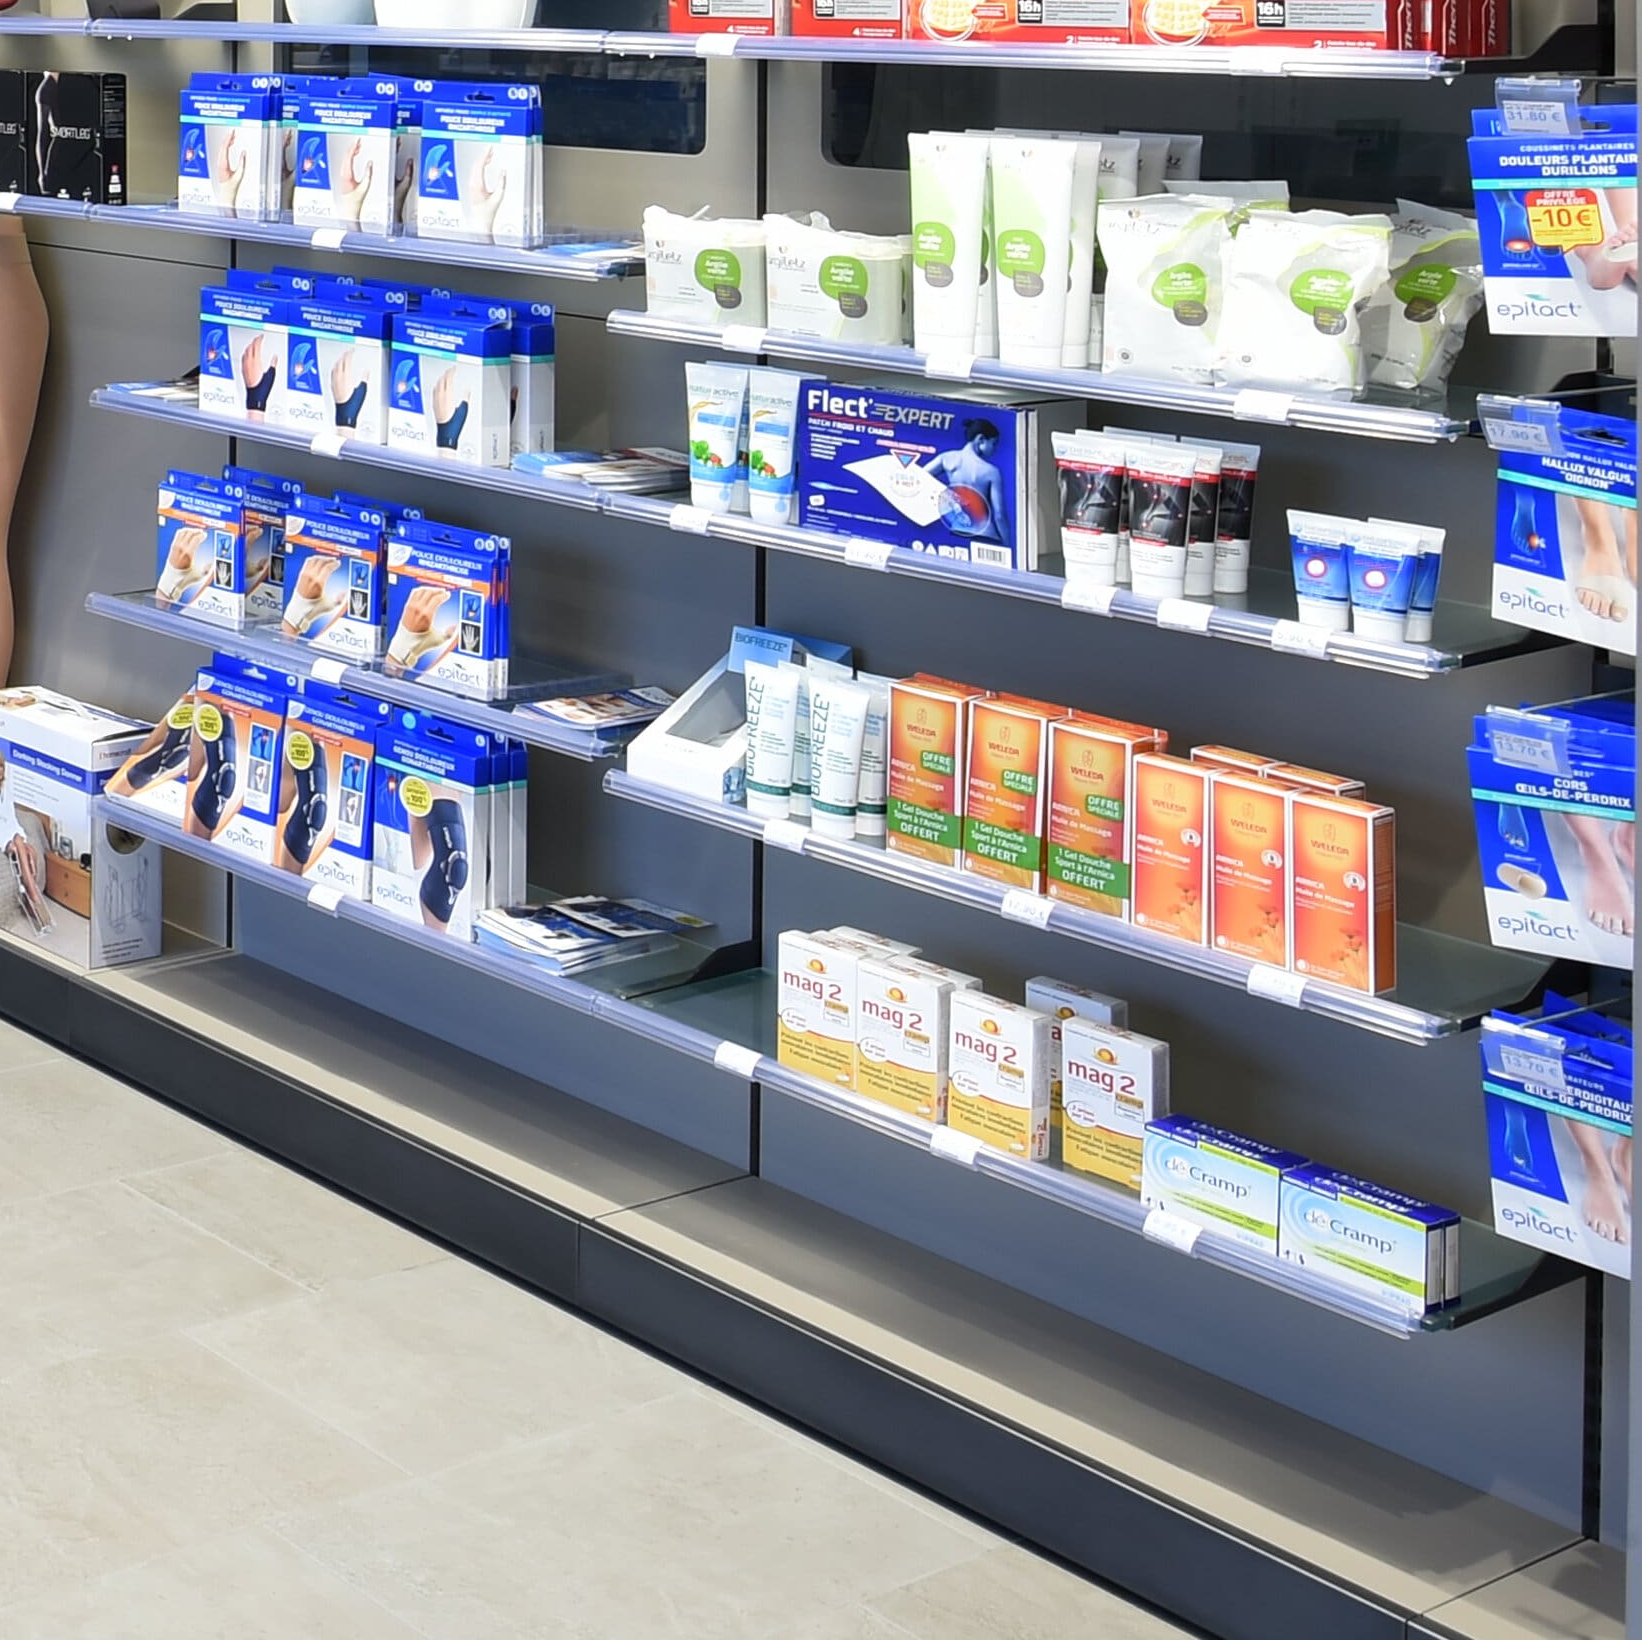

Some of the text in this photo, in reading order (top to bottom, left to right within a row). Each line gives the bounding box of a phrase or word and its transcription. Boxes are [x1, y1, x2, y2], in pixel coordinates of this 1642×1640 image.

[1018, 0, 1041, 13] 16h
[1257, 2, 1284, 16] 16h
[1507, 111, 1561, 122] 31.80 €
[1520, 143, 1635, 152] COUSSINETS PLANTAIRES
[1499, 155, 1568, 166] DOULEURS
[1542, 165, 1617, 175] DURILLONS
[1543, 190, 1576, 199] OFFRE
[1497, 301, 1577, 320] epitact
[885, 406, 955, 430] EXPERT
[832, 421, 854, 431] FROID
[856, 425, 865, 433] ET
[867, 427, 894, 437] CHAUD
[1542, 456, 1635, 485] HALLUX VALGUS,
[1500, 590, 1565, 618] epitact
[328, 631, 368, 649] epitact
[734, 633, 786, 653] BIOFREEZE
[438, 667, 480, 686] epitact
[746, 677, 765, 777] BIOFREEZE
[907, 723, 936, 738] WELEDA
[811, 695, 830, 796] BIOFREEZE
[923, 752, 951, 764] OFFRE
[1004, 771, 1034, 785] OFFRE
[1071, 766, 1104, 781] WELEDA
[1554, 778, 1588, 792] CORS
[1087, 796, 1119, 810] OFFRE
[1515, 783, 1631, 808] ŒILS-DE-PERDRIX
[903, 804, 915, 812] Gel
[916, 807, 944, 821] Douche
[900, 822, 939, 841] OFFERT
[980, 824, 992, 833] Gel
[994, 827, 1024, 842] Douche
[1231, 818, 1267, 835] WELEDA
[978, 843, 1018, 863] OFFERT
[1310, 839, 1350, 857] WELEDA
[1064, 850, 1077, 861] Gel
[1079, 854, 1111, 870] Douche
[317, 863, 355, 885] epitact
[1062, 870, 1106, 890] OFFERT
[1498, 916, 1576, 941] epitact
[783, 969, 842, 1001] mag 2
[862, 997, 923, 1031] mag 2
[955, 1028, 1017, 1064] mag 2
[1067, 1058, 1135, 1095] mag 2
[1501, 1208, 1574, 1243] epitact
